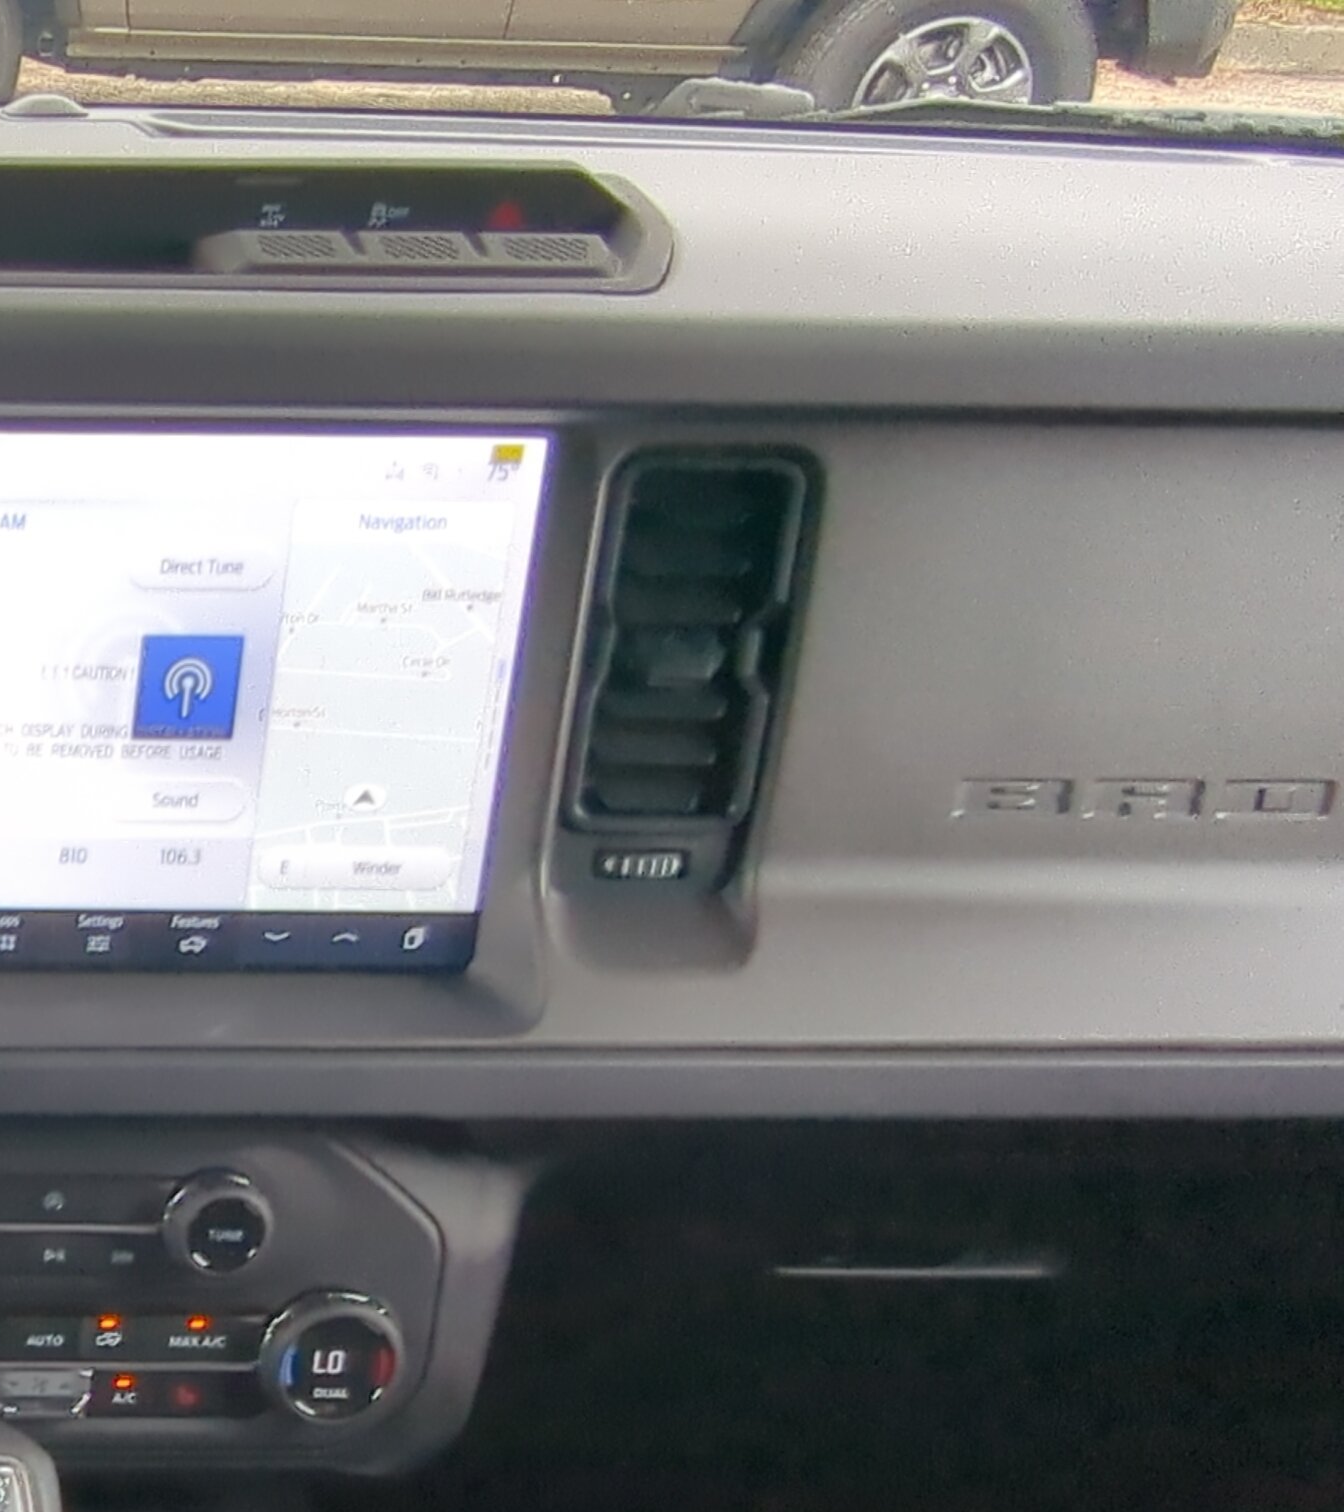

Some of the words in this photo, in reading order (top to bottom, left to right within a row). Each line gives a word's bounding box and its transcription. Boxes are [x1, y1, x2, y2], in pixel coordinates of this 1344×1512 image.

[0, 513, 27, 531] AM
[358, 513, 448, 534] Navigation
[159, 557, 203, 575] Direct
[206, 557, 244, 575] Tune
[21, 723, 73, 738] DISPLAY
[179, 746, 223, 761] USAGE
[152, 792, 199, 809] Sound
[58, 847, 89, 865] 810
[160, 847, 202, 866] 106.3
[279, 860, 290, 875] E
[353, 860, 403, 876] Winder
[76, 914, 124, 931] Settings
[170, 914, 220, 930] Features
[26, 1333, 65, 1348] AUTO
[169, 1335, 200, 1349] MAX
[201, 1334, 228, 1350] A/C
[312, 1350, 347, 1376] LO
[112, 1391, 137, 1406] A/C
